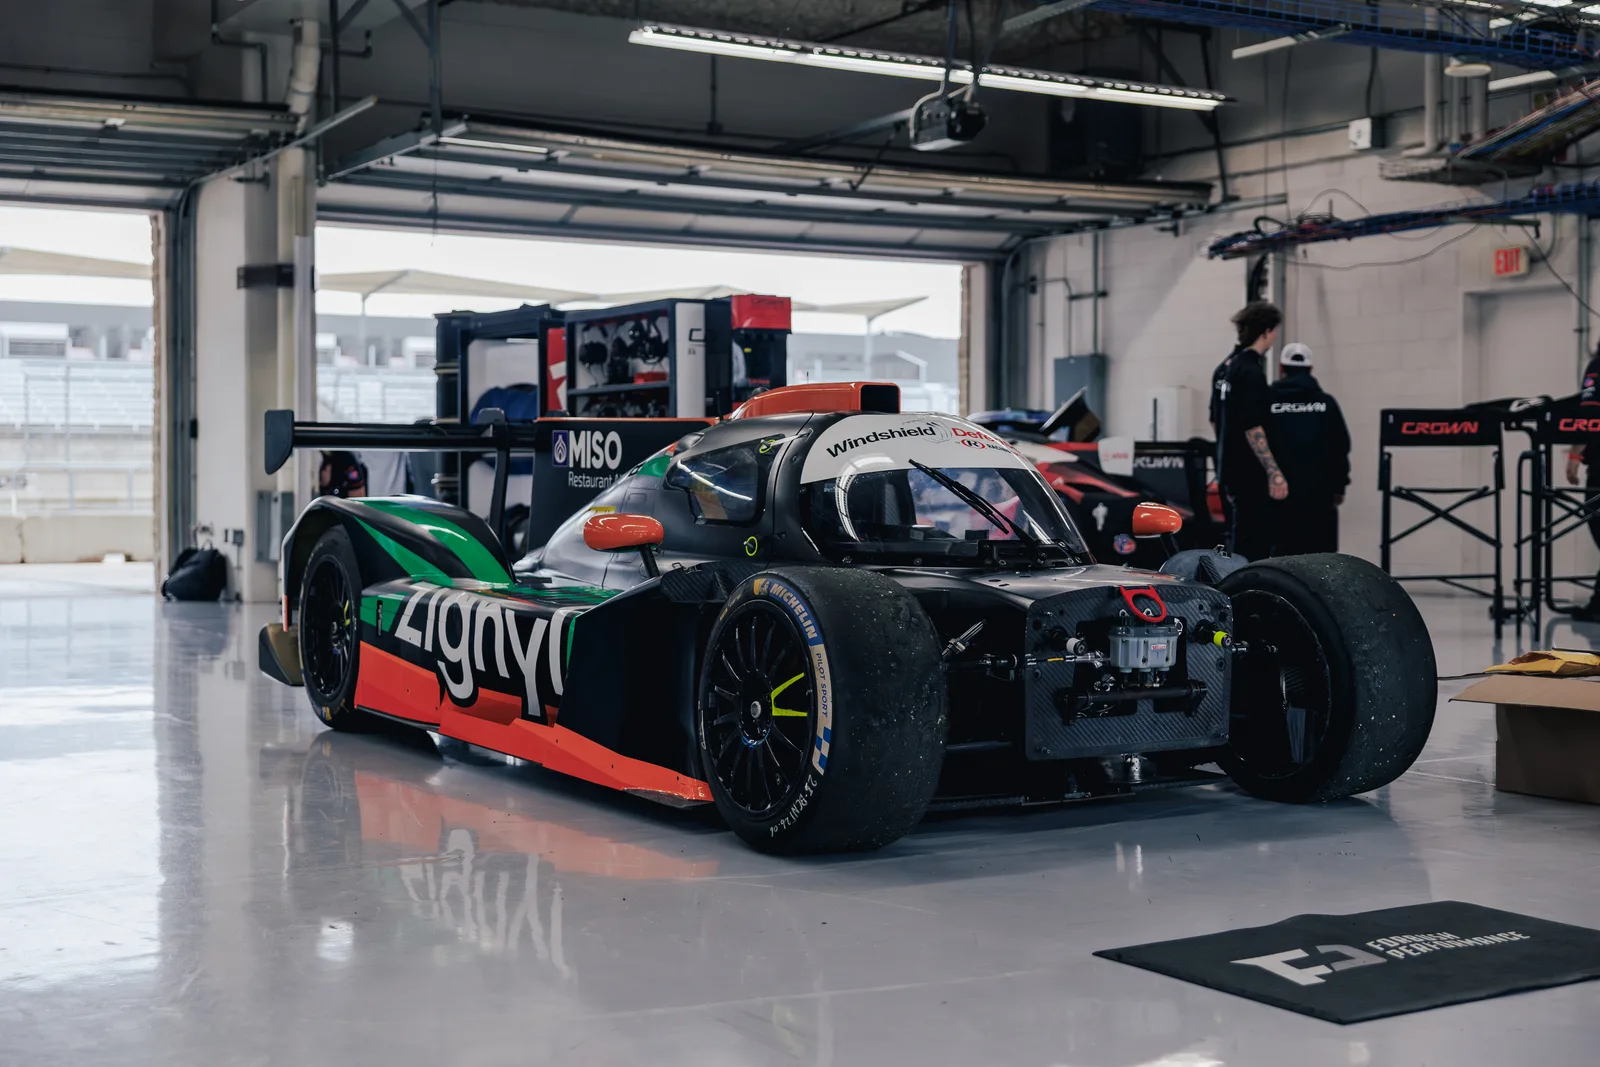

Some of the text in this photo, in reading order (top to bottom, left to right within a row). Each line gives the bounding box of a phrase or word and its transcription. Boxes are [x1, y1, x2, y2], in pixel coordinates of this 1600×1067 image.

[1494, 248, 1521, 275] EXIT
[826, 426, 936, 458] Windshield
[1401, 421, 1479, 435] CROWN
[568, 430, 623, 470] MISO
[568, 471, 612, 488] Restaurant
[770, 583, 818, 640] MICHELIN
[815, 652, 828, 718] PILOT SPORT
[1386, 931, 1531, 959] PERFORMANCE
